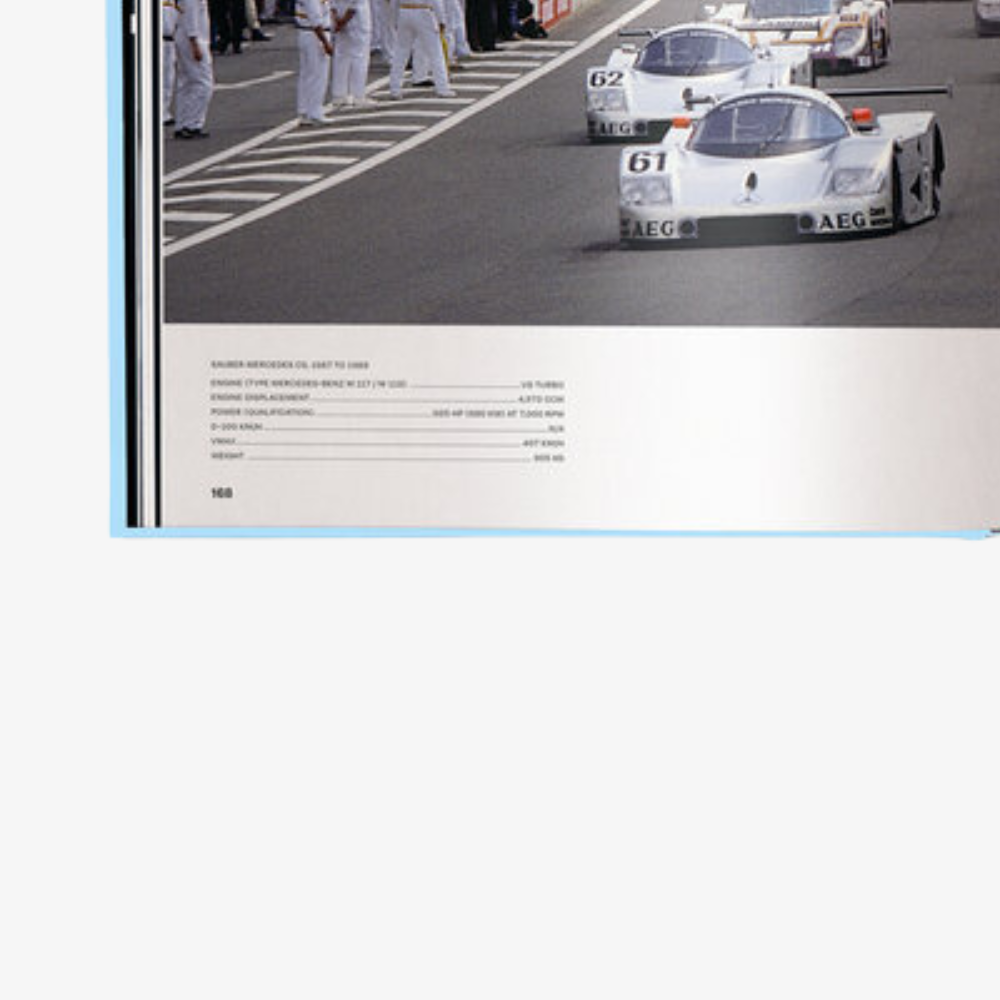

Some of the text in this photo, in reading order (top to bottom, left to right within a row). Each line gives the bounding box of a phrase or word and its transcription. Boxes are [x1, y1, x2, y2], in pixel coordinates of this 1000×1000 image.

[589, 70, 624, 88] 62
[600, 120, 631, 135] AEG
[628, 151, 666, 172] 61
[631, 219, 674, 237] AEG
[819, 213, 867, 230] AEG
[210, 379, 242, 388] ENGINE
[534, 380, 565, 389] TURBO
[210, 394, 242, 402] ENGINE
[244, 393, 311, 402] DISPLACEMENT
[210, 408, 241, 417] POWER
[506, 409, 518, 417] AT
[210, 452, 244, 461] WEIGHT
[210, 486, 233, 499] 168
